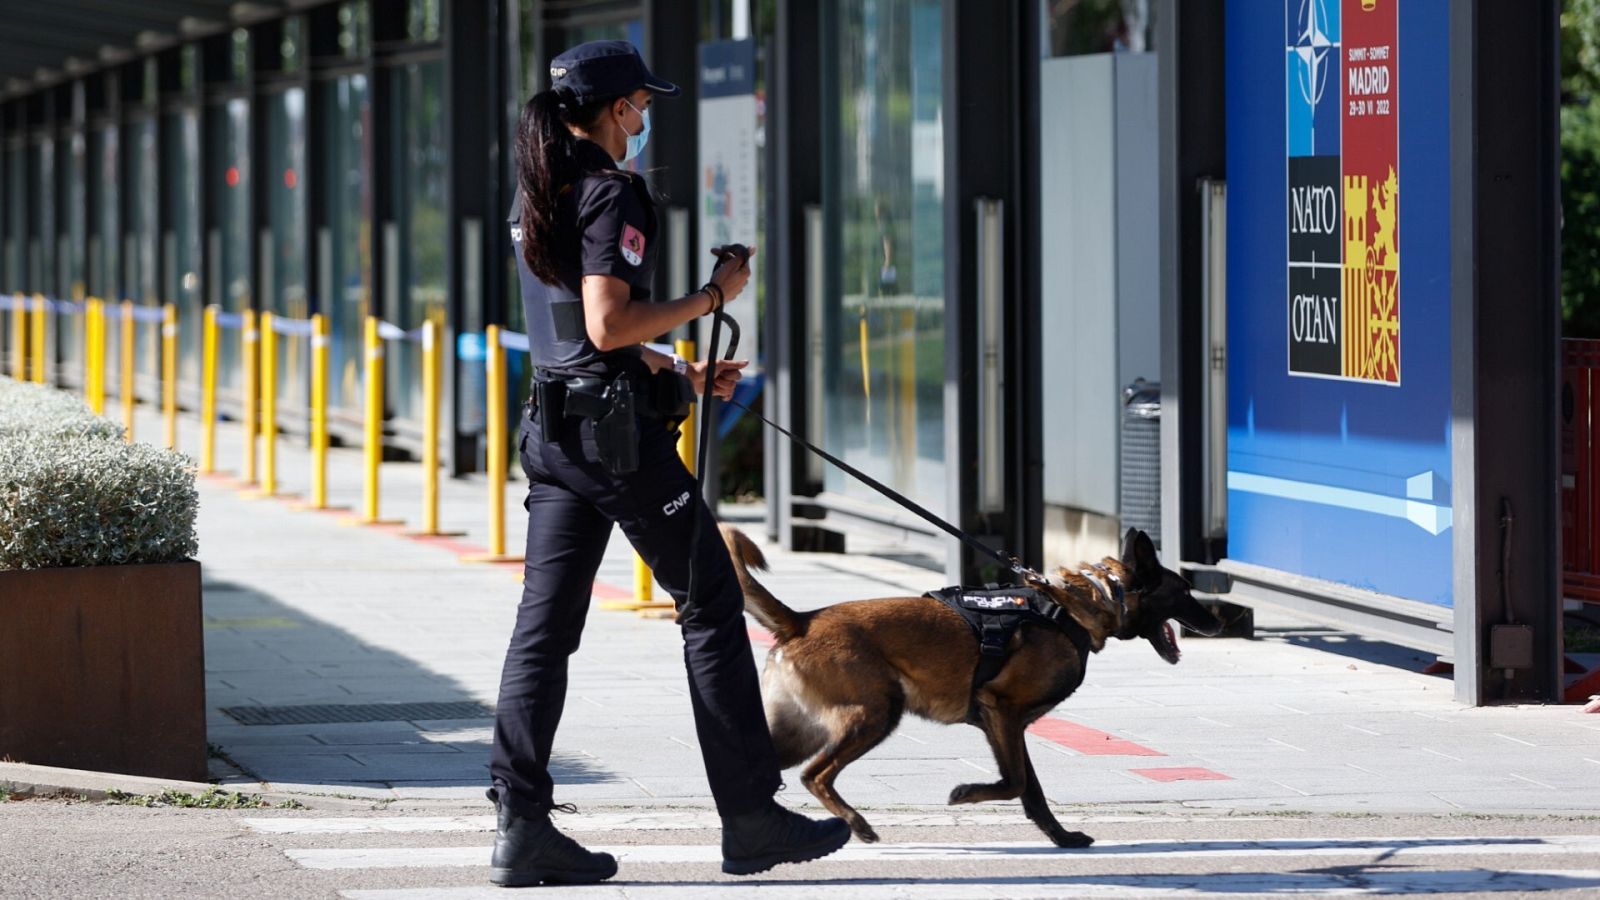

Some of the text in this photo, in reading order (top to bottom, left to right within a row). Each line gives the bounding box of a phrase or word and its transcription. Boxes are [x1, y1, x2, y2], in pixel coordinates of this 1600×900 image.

[1349, 48, 1366, 62] SUMMIT
[1370, 46, 1389, 60] SOMMET
[1349, 66, 1389, 96] MADRID
[1350, 100, 1390, 116] 29-30 VI 2022
[1292, 185, 1336, 234] NATO
[1292, 294, 1337, 344] OTAN
[662, 491, 690, 516] CNP
